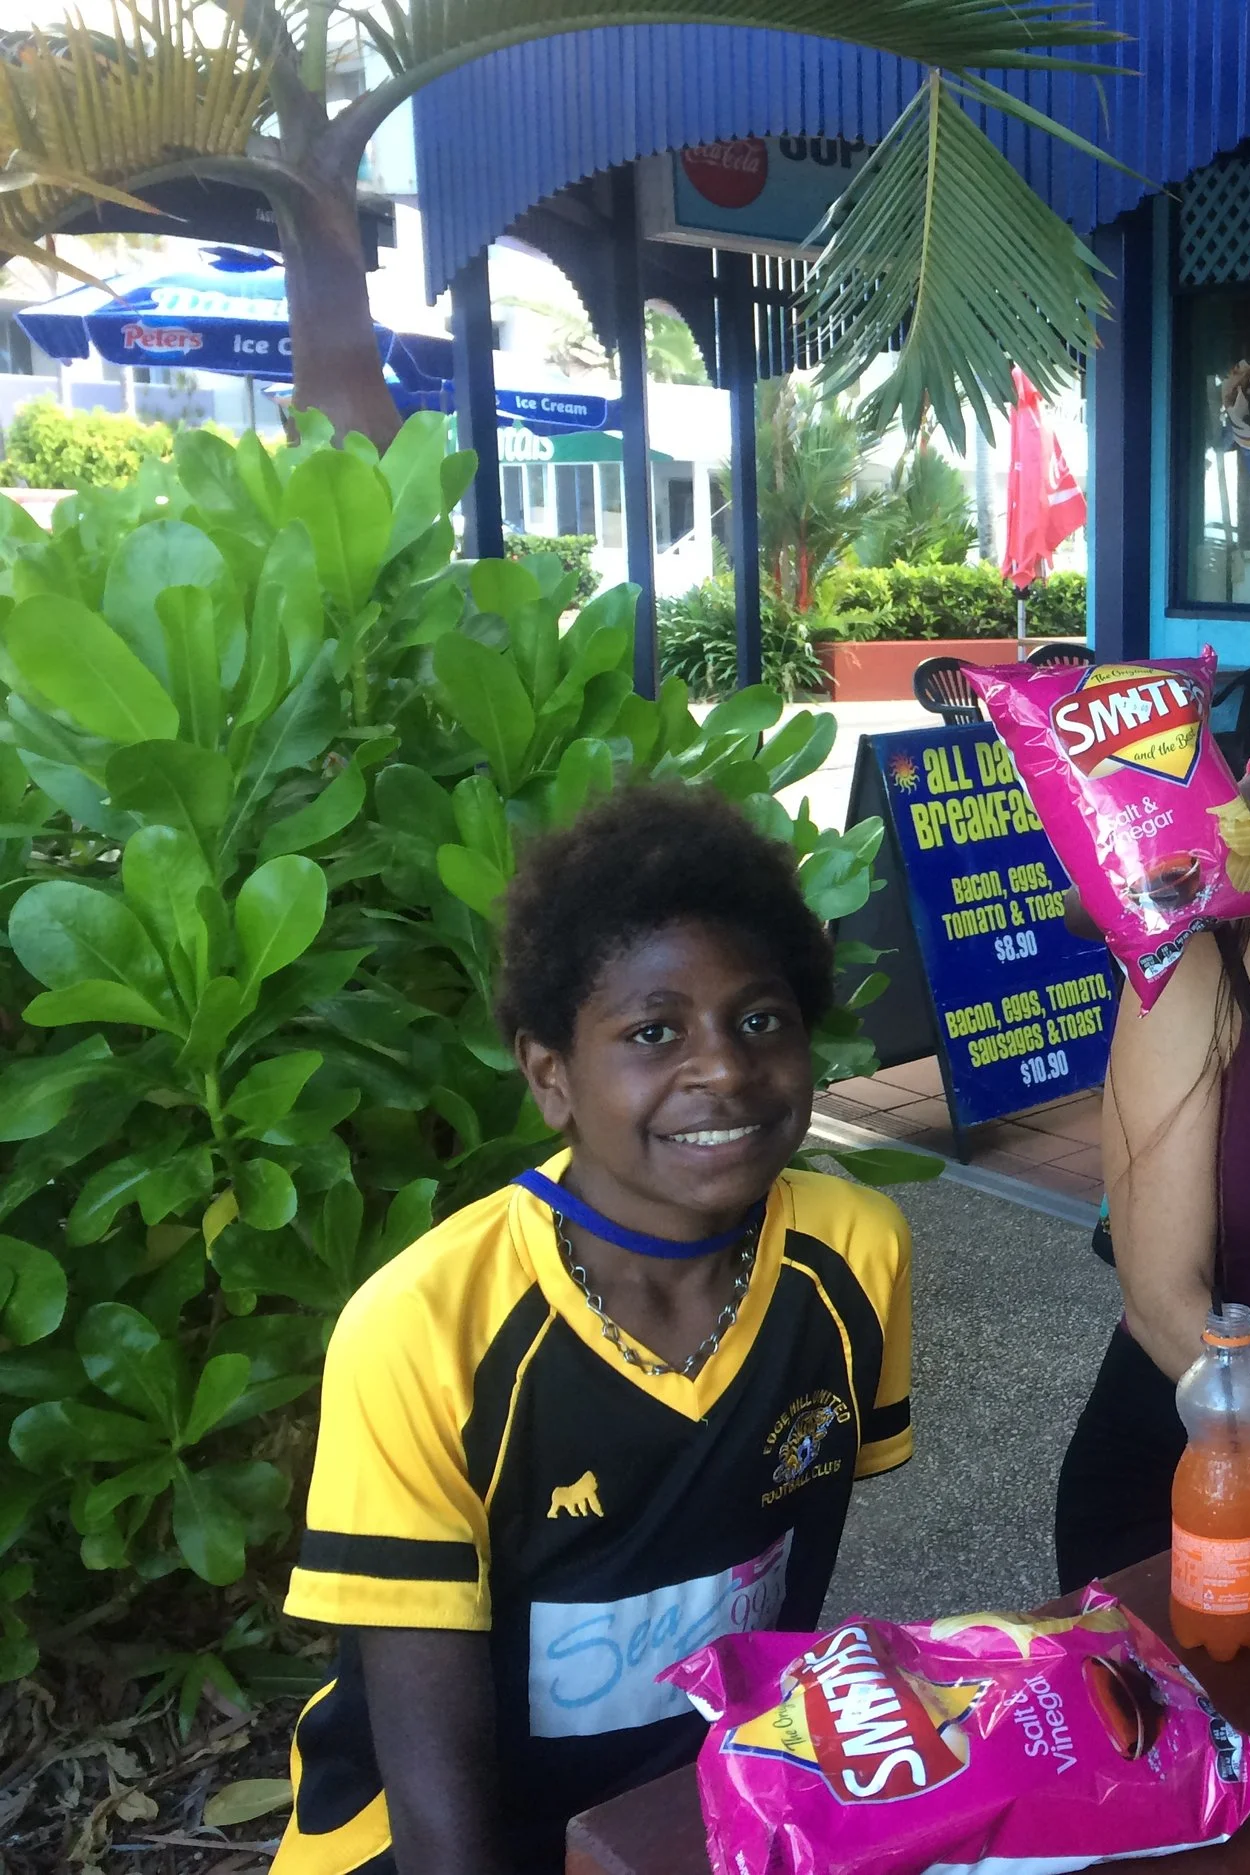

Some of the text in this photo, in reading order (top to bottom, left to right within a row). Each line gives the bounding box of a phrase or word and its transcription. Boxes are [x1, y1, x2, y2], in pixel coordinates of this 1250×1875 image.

[121, 322, 203, 352] Peters
[233, 334, 270, 355] Ice
[515, 395, 537, 410] Ice
[541, 397, 588, 416] Cream
[1090, 671, 1111, 684] The
[1133, 727, 1197, 761] and the Best
[1142, 796, 1159, 814] &
[1008, 861, 1053, 894] eggs,
[1009, 900, 1025, 927] &
[994, 929, 1039, 964] $8.90
[1001, 989, 1047, 1025] eggs,
[1019, 1049, 1070, 1088] $10.90
[789, 1393, 812, 1416] HILL
[761, 1459, 842, 1508] FOOTBALL CLUB
[1004, 1689, 1028, 1706] &
[780, 1729, 807, 1752] The
[1013, 1705, 1049, 1758] Salt
